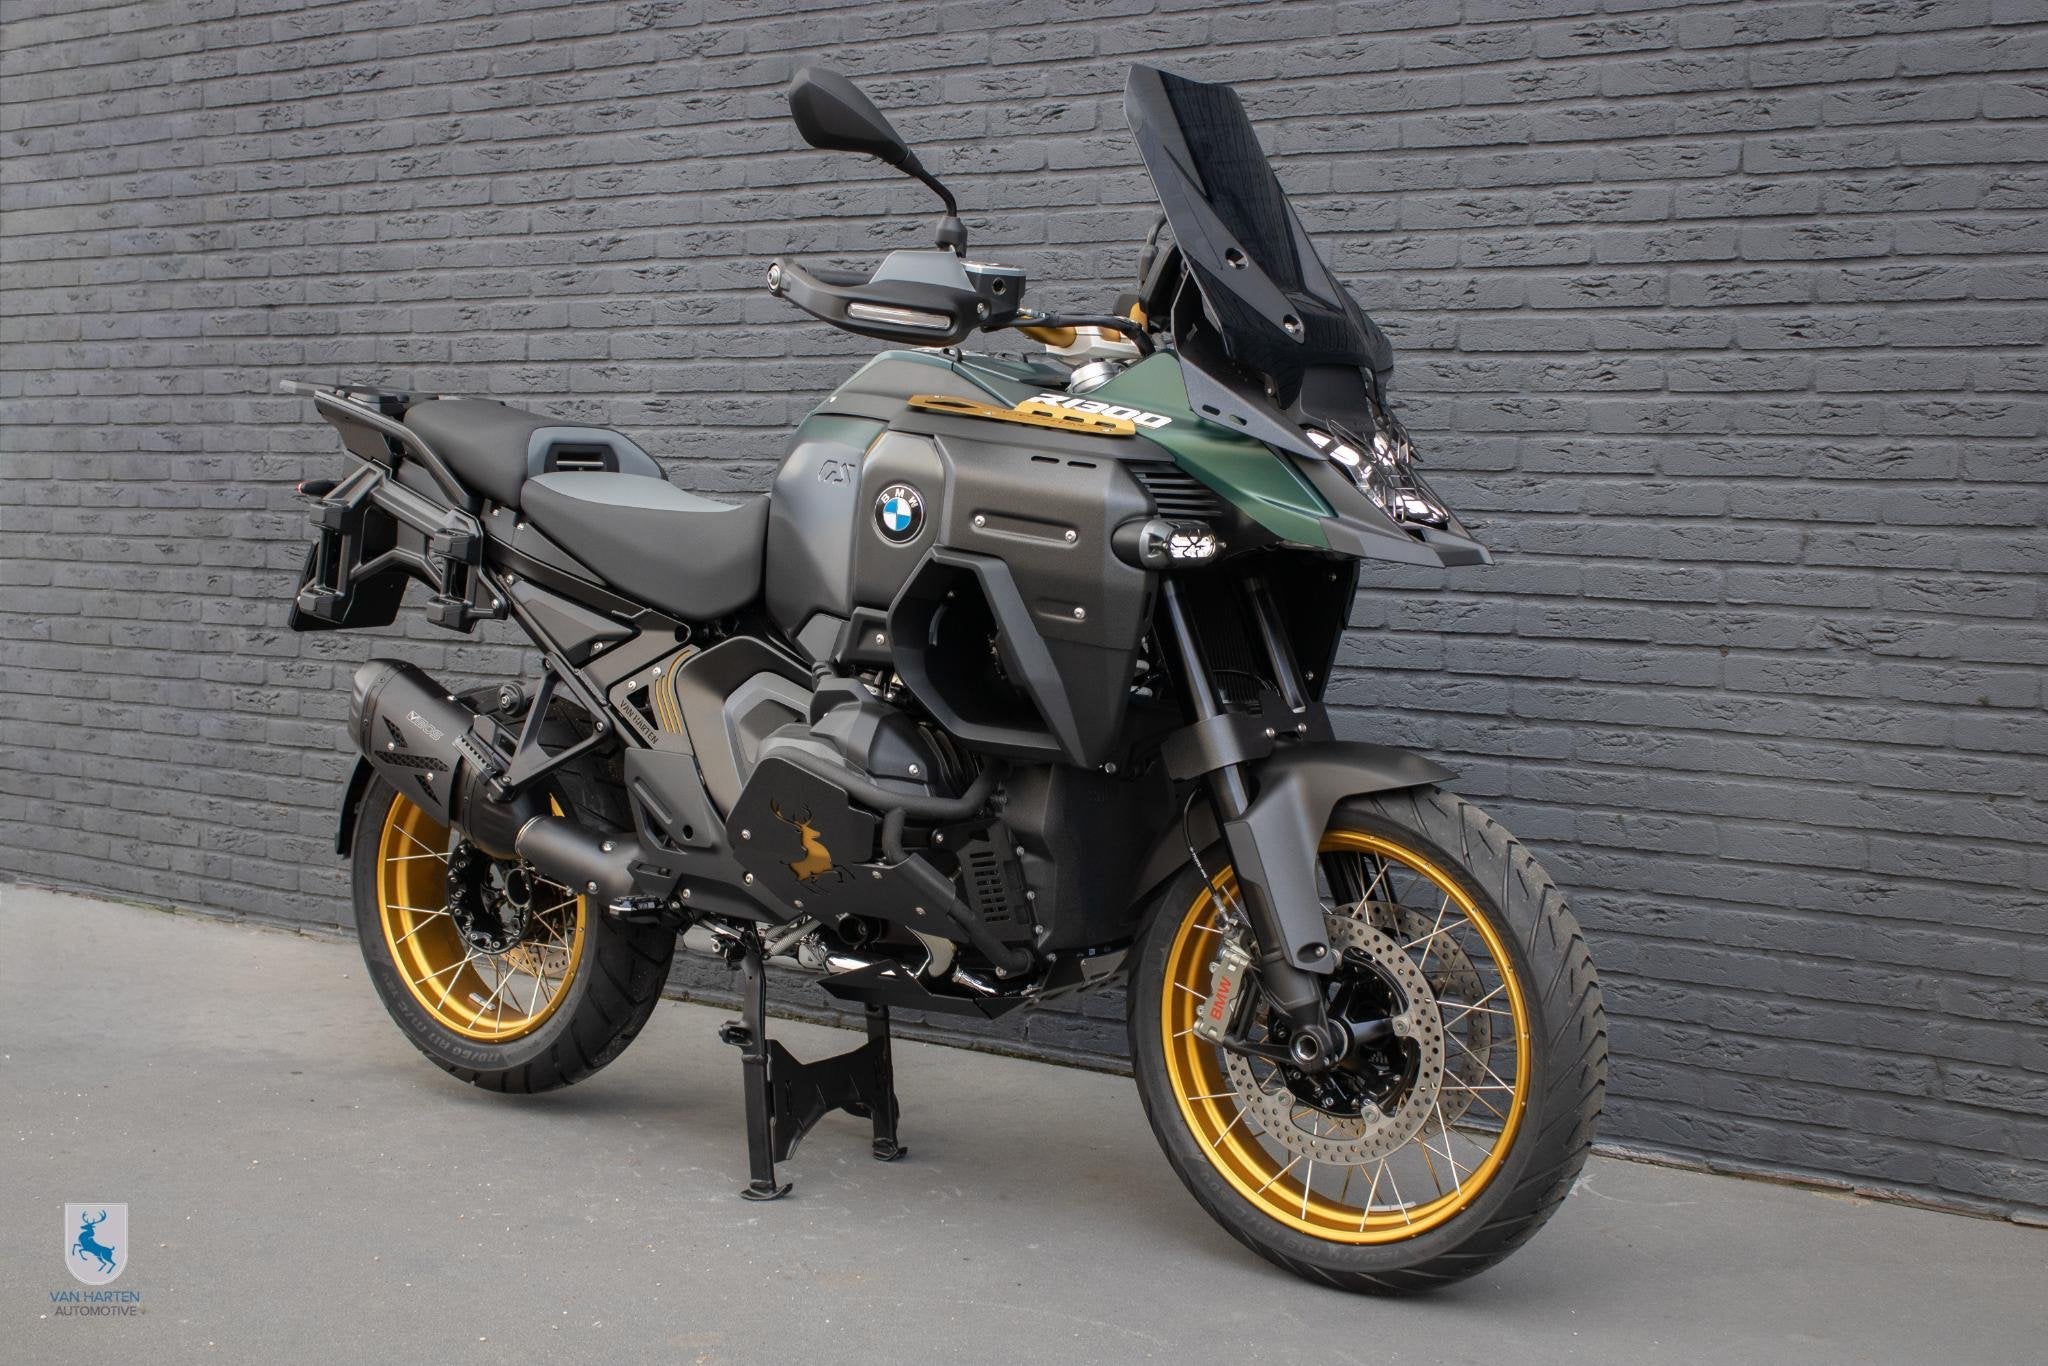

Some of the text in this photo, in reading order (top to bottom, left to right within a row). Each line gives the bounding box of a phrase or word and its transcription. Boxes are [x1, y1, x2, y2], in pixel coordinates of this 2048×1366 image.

[1027, 393, 1172, 429] R1300
[881, 488, 918, 508] BMW
[620, 700, 659, 744] VAN HARTEN
[1211, 975, 1231, 1020] BMW
